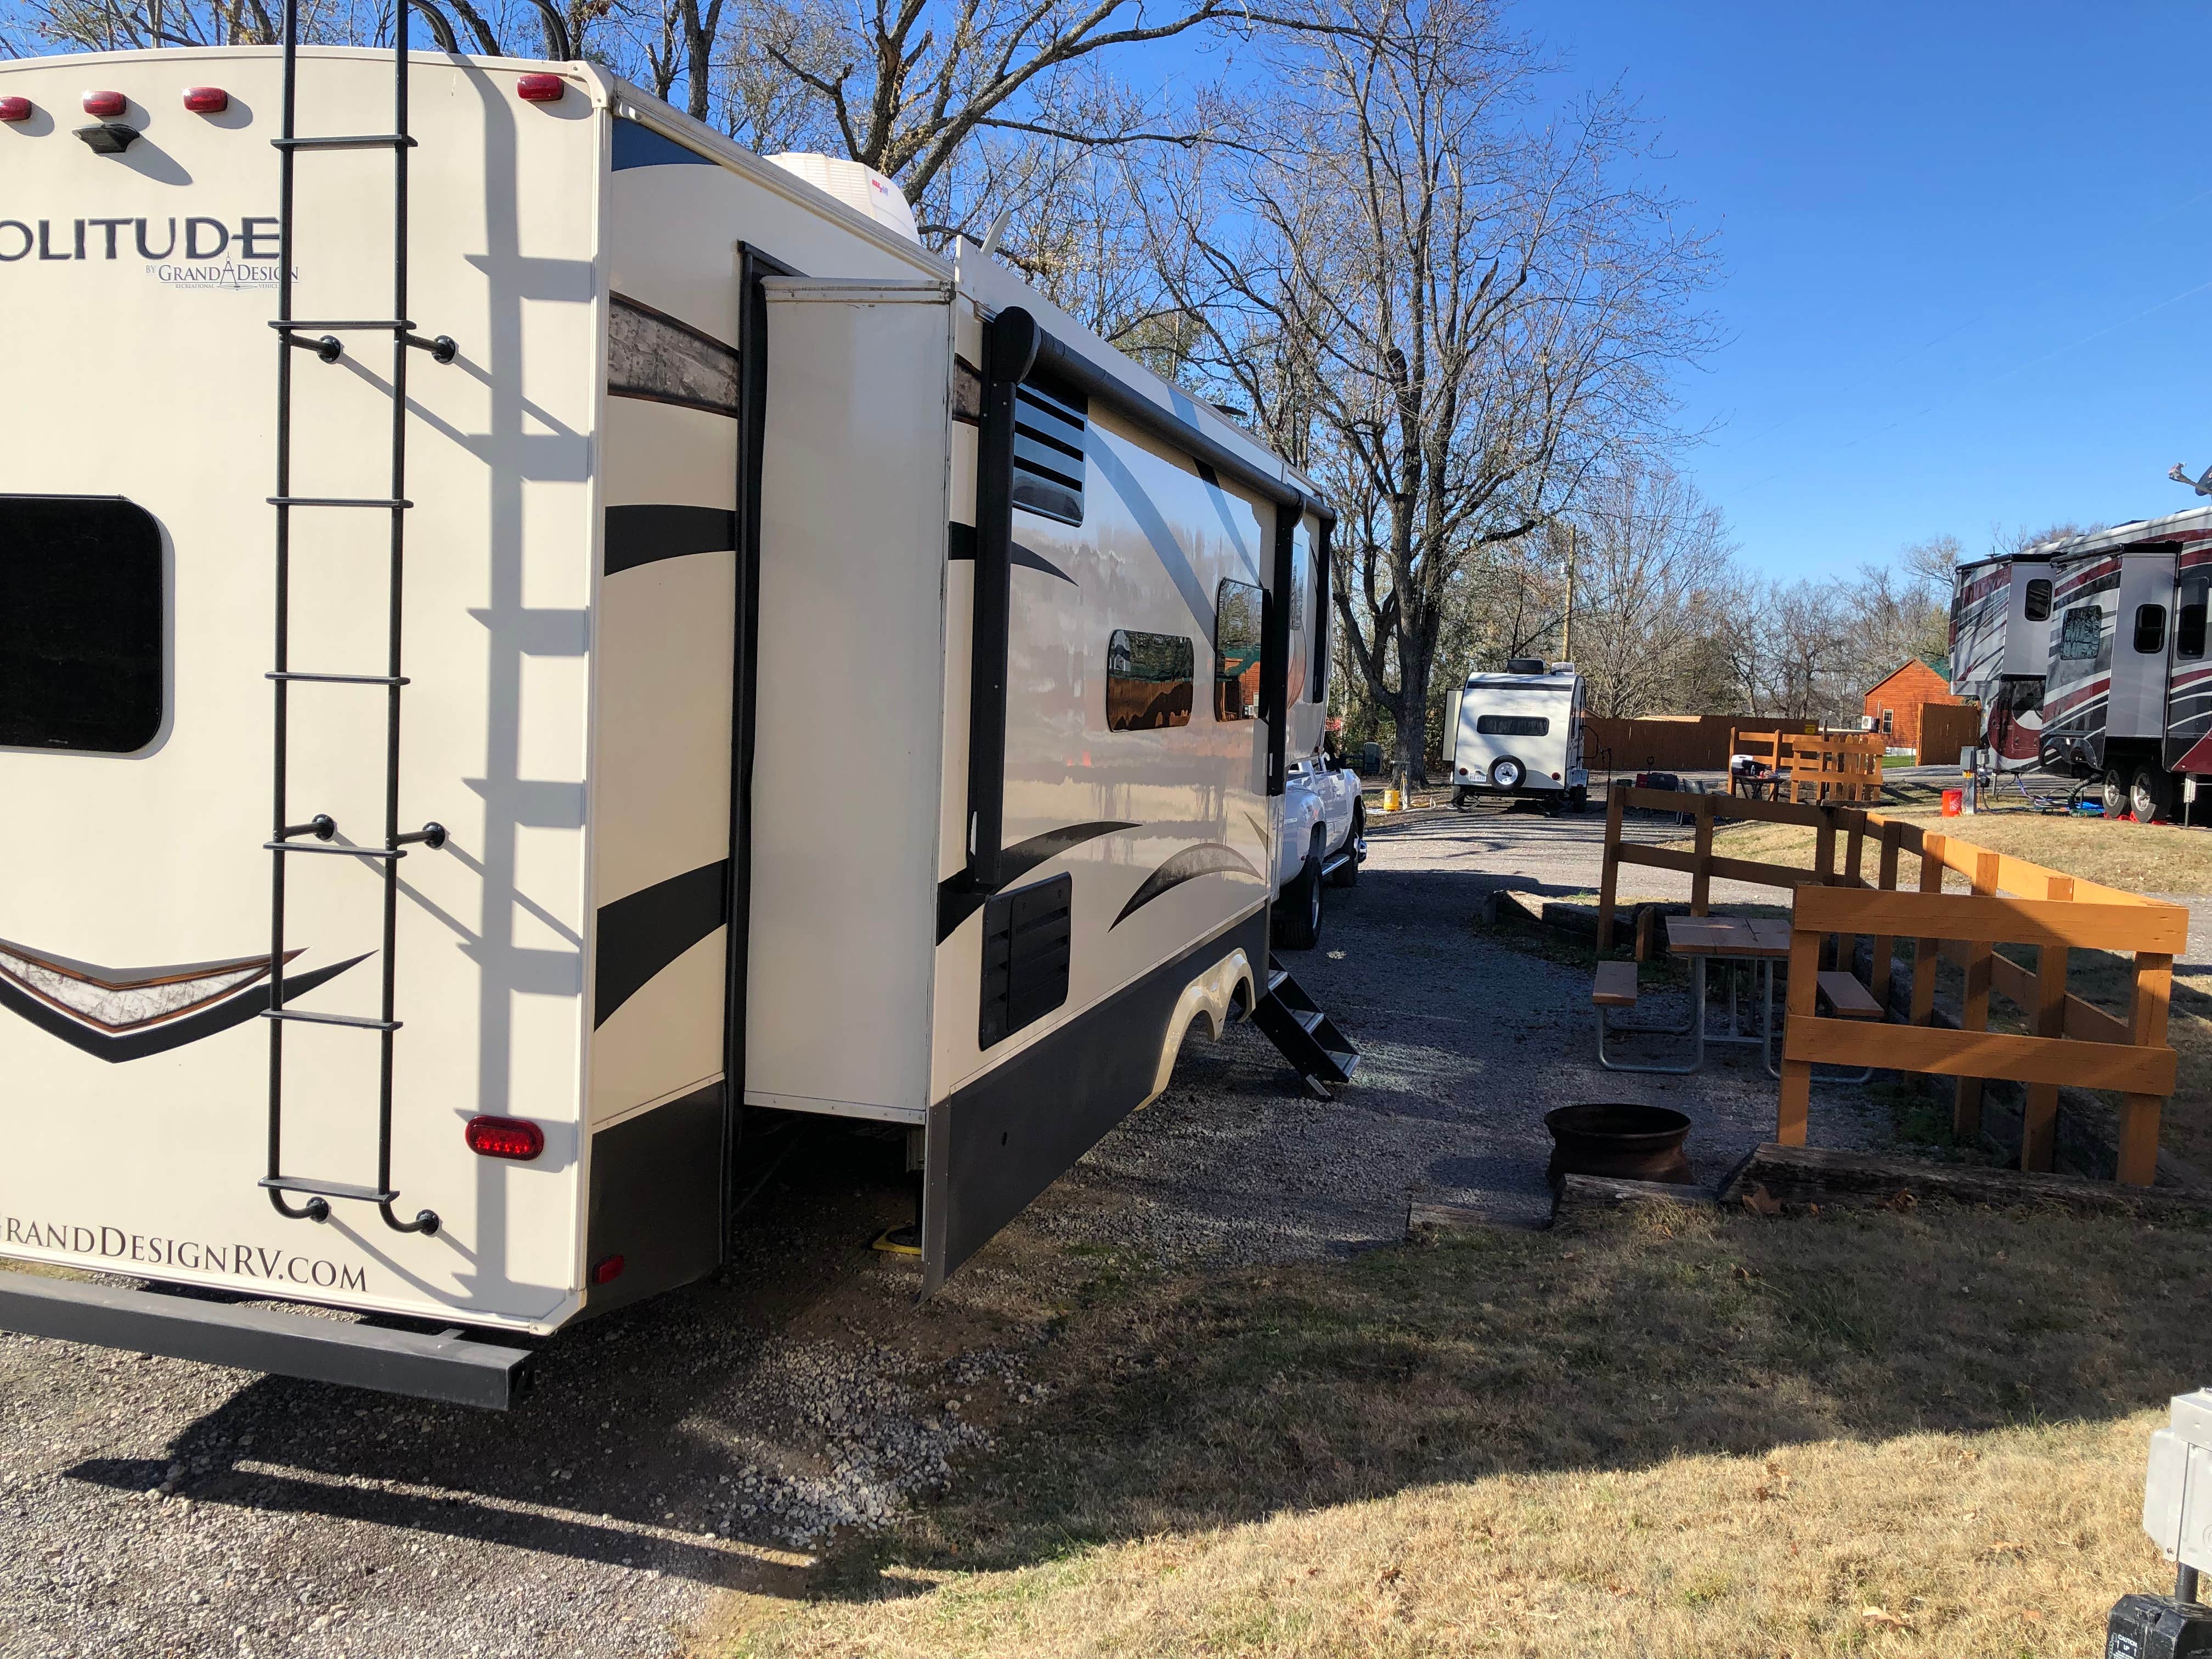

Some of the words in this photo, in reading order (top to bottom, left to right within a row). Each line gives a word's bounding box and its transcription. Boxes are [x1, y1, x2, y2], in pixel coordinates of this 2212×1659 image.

[145, 265, 155, 273] BY
[158, 264, 220, 281] GRAND
[0, 1216, 369, 1293] RANDDESIGNRV.COM
[2118, 1634, 2137, 1648] CAUTION
